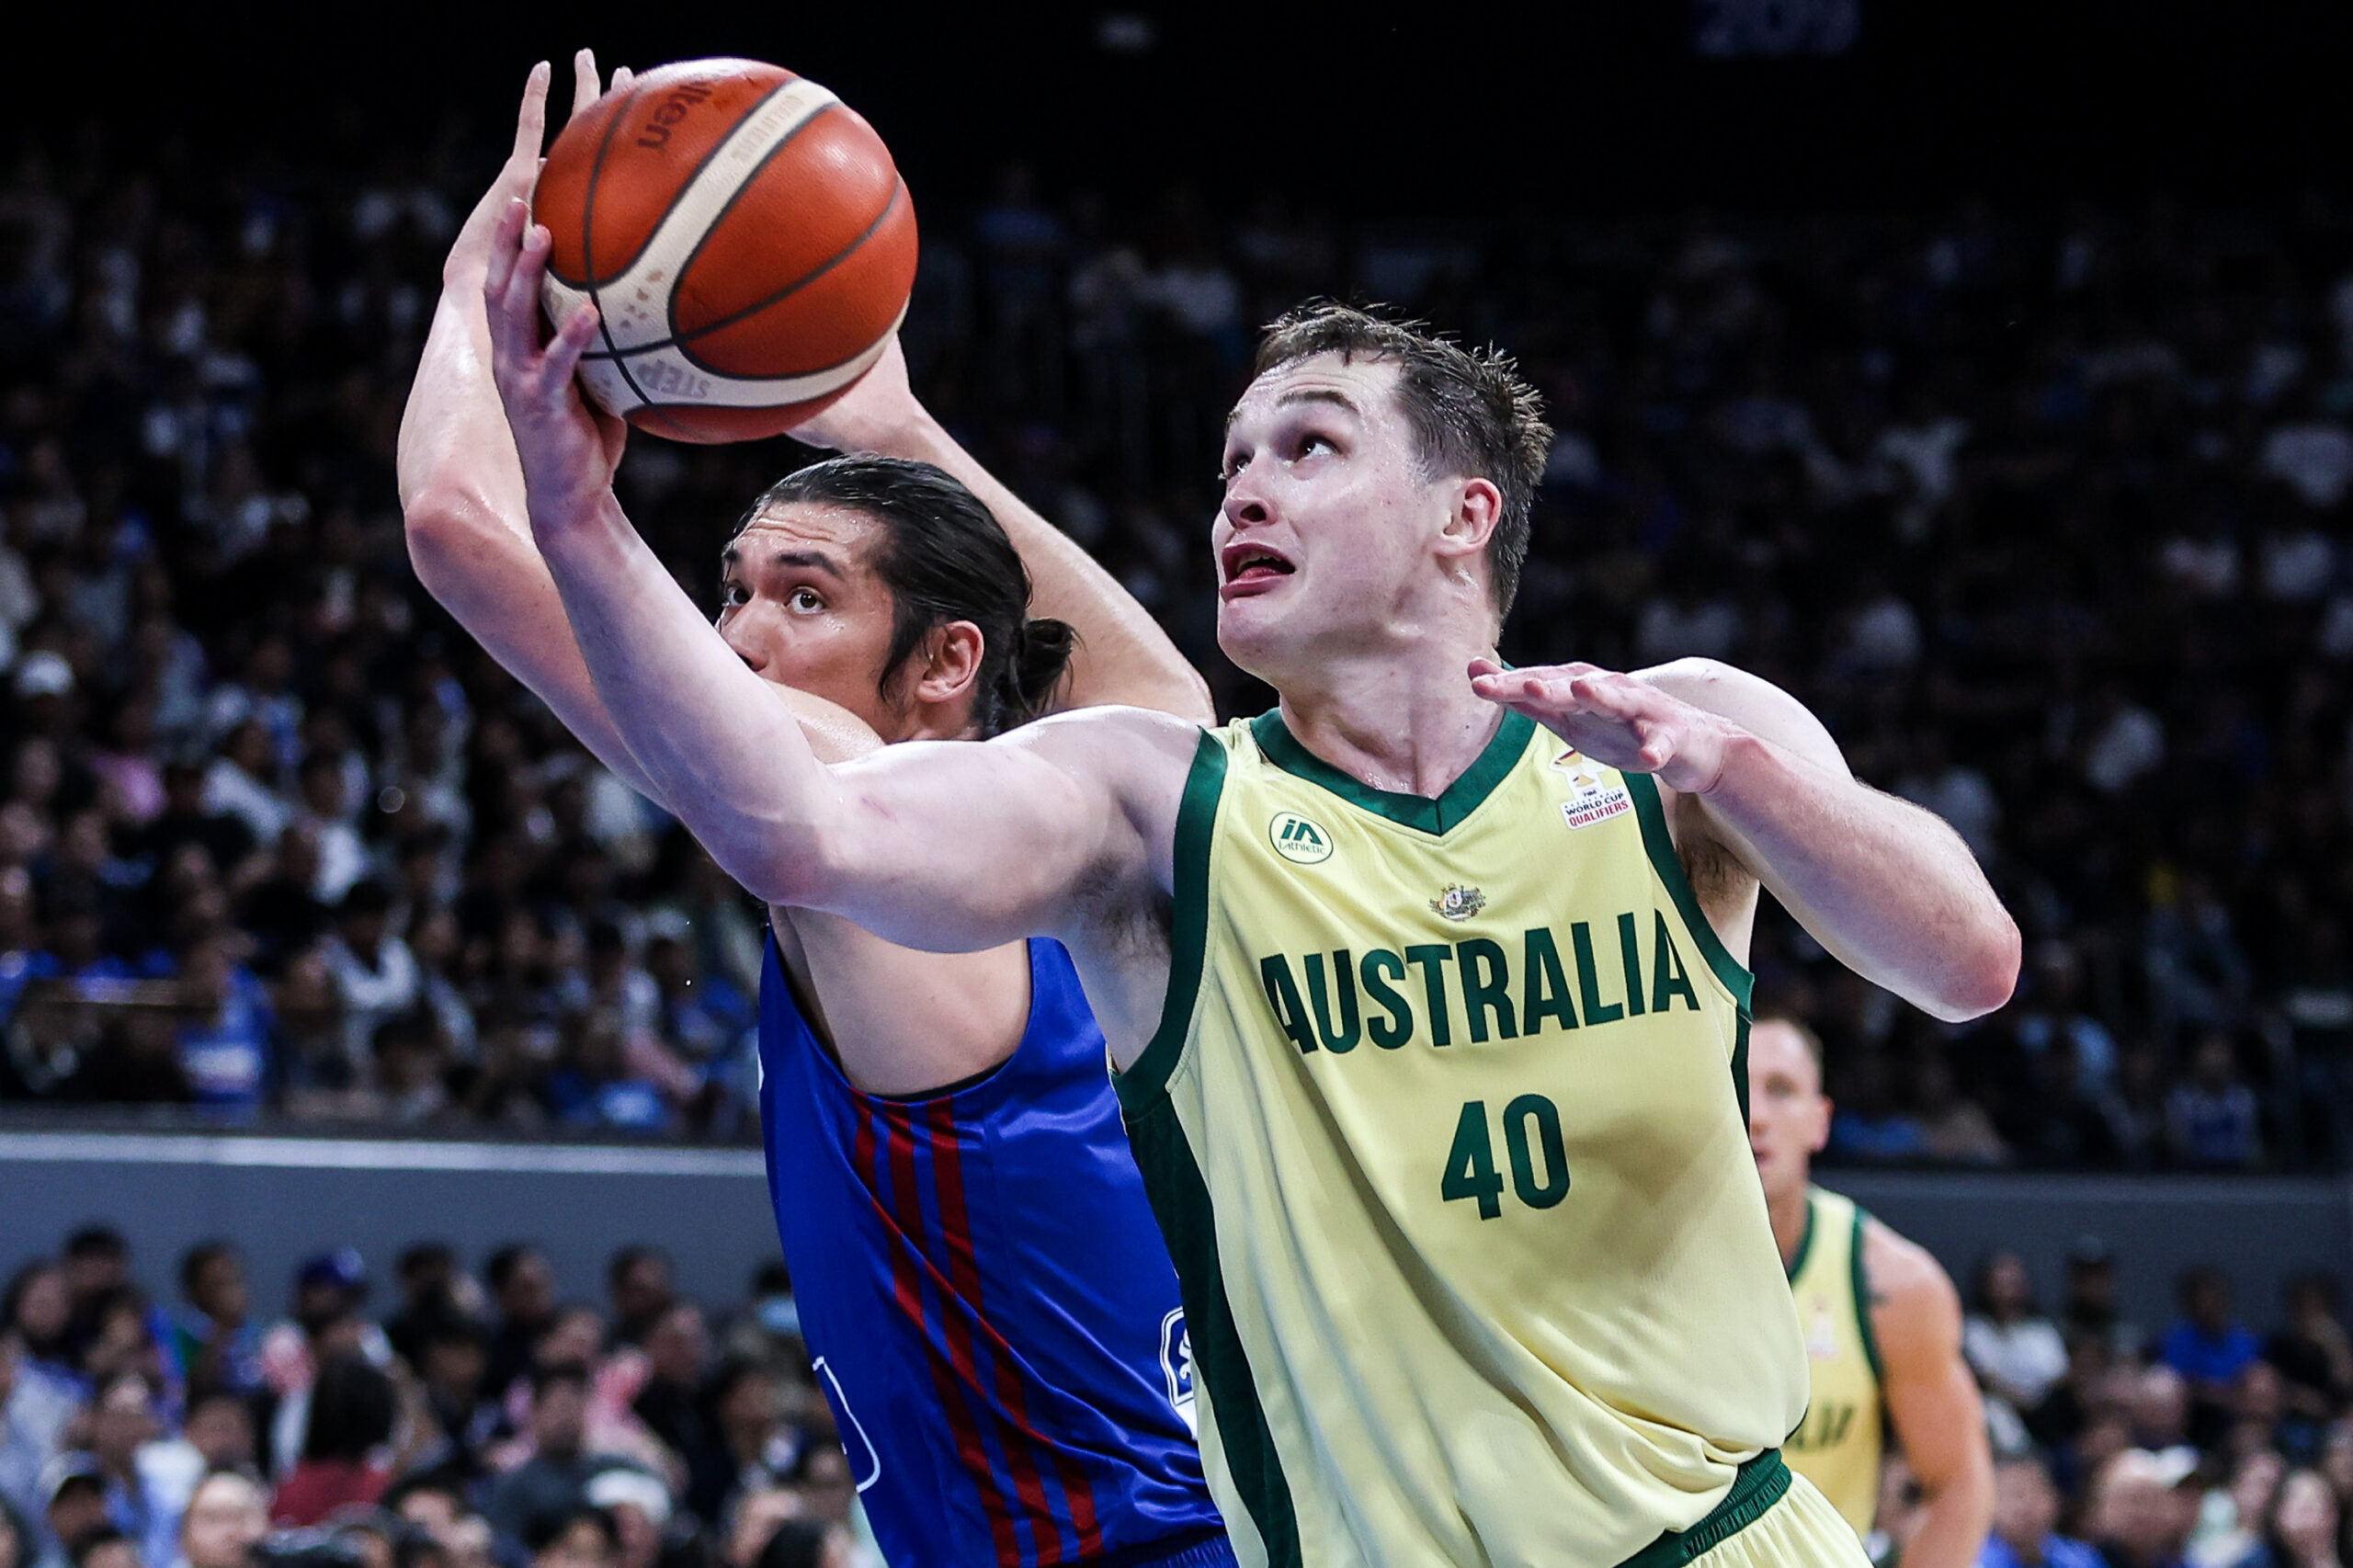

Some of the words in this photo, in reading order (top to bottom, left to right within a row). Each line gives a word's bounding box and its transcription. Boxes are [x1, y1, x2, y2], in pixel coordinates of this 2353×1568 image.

[637, 79, 715, 150] lten
[1565, 800, 1603, 815] WORLD
[1604, 792, 1624, 804] CUP
[1568, 800, 1629, 827] QUALIFIERS
[1260, 908, 1700, 1055] AUSTRALIA
[1440, 1094, 1571, 1221] 40
